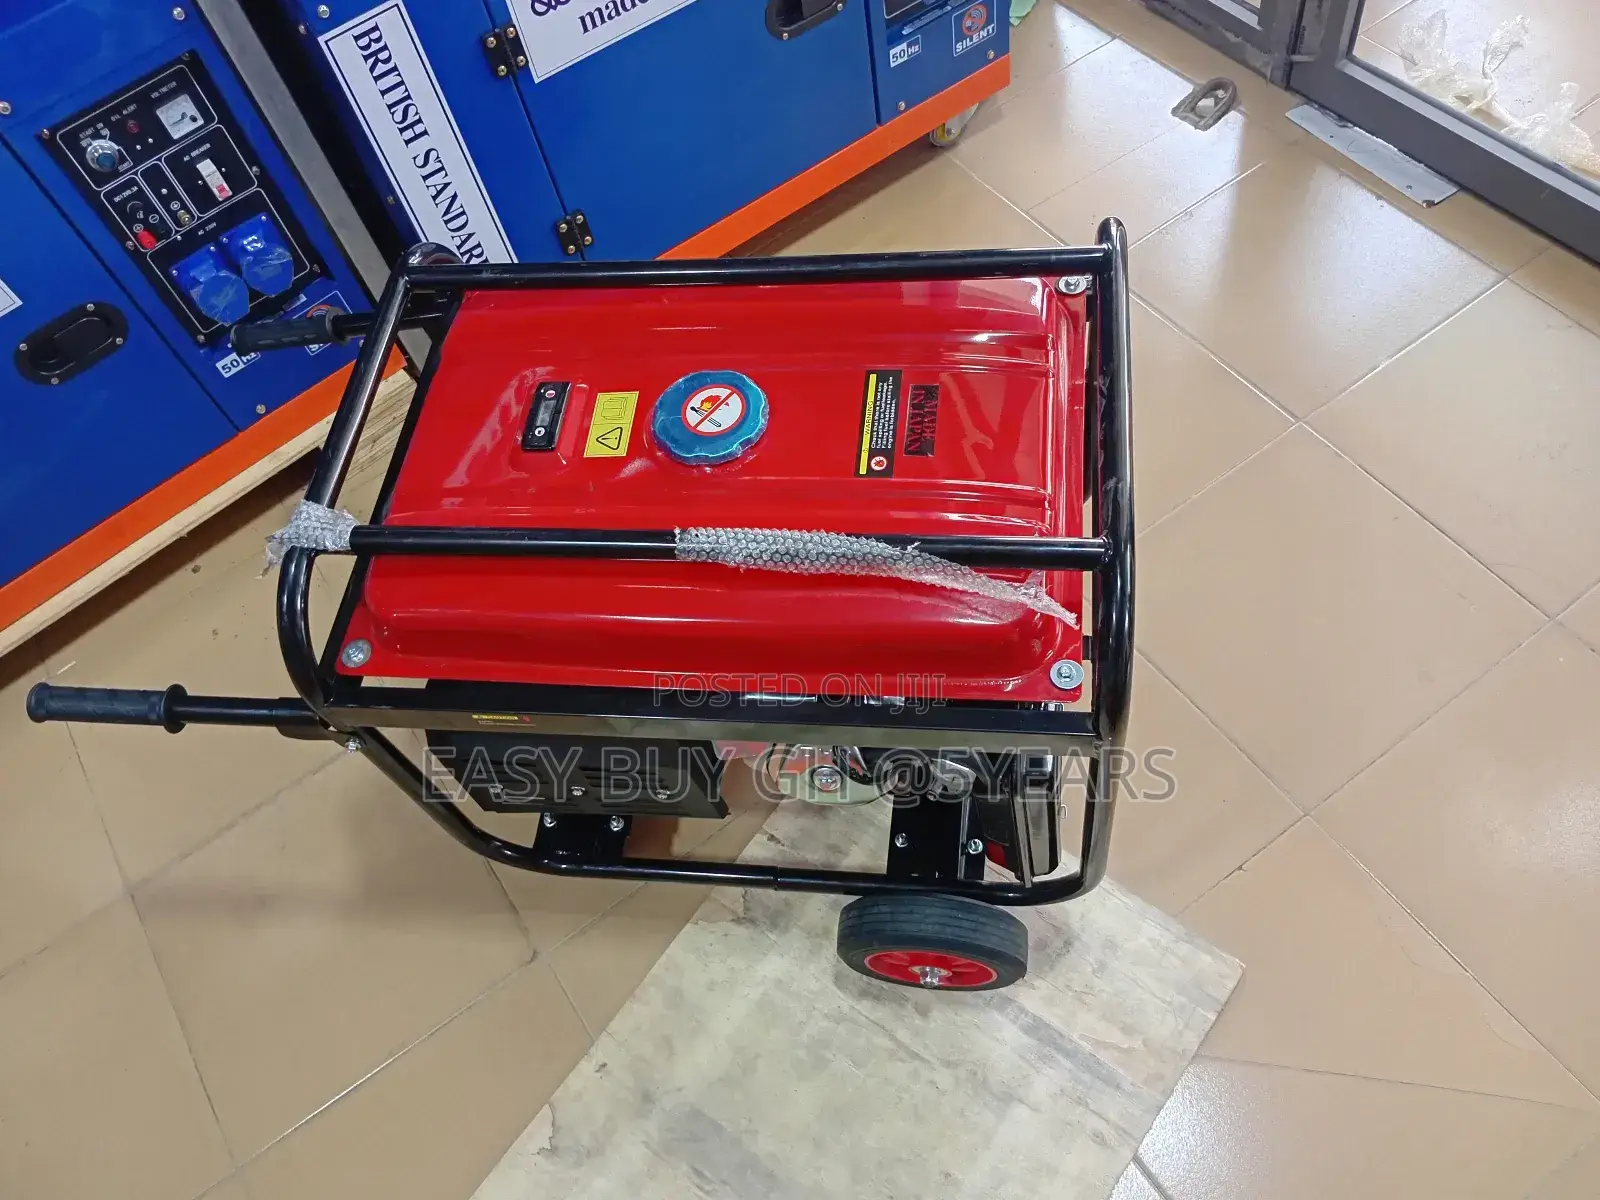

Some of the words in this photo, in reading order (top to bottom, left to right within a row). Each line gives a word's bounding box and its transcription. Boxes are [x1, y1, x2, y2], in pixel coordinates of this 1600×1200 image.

[956, 24, 995, 52] SILENT
[110, 114, 121, 122] OIL
[122, 103, 137, 115] ALERT
[190, 143, 211, 158] BREAKER
[352, 22, 430, 148] BRITISH
[412, 148, 490, 264] STANDAR
[911, 390, 925, 404] IN
[865, 401, 873, 436] WARNING
[908, 410, 924, 451] JAPAN
[922, 400, 937, 440] MADE
